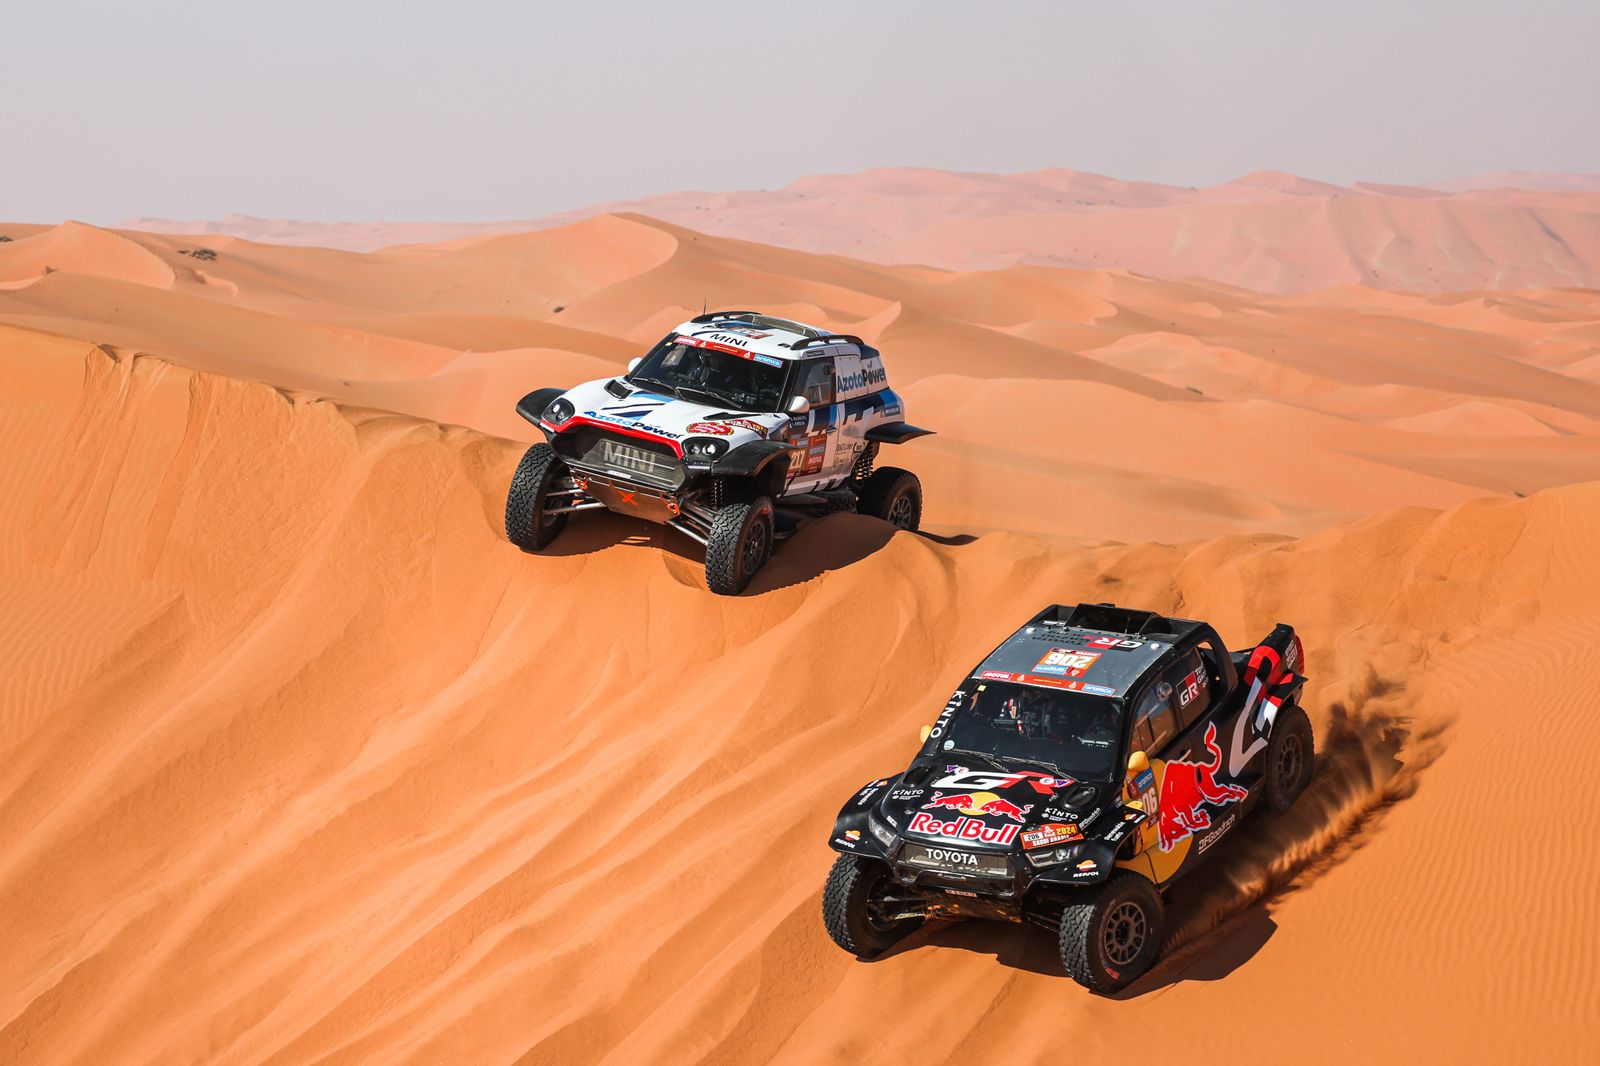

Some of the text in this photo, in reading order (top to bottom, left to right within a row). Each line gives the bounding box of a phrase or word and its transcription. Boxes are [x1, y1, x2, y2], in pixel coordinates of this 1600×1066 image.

[709, 333, 748, 347] MINI
[754, 354, 781, 367] aramco
[836, 367, 886, 393] AzotoPower
[583, 410, 686, 439] AzotoPower
[603, 441, 656, 473] MINI
[1093, 636, 1144, 650] GR
[1044, 652, 1092, 669] 206
[983, 672, 1011, 680] MOTUL
[1084, 685, 1113, 695] aramco
[1180, 681, 1199, 707] GR
[931, 770, 1075, 797] GR
[1078, 807, 1101, 829] BFGoodrich
[908, 812, 1022, 846] Red Bull
[1027, 833, 1040, 841] 206
[1055, 826, 1077, 837] 2024
[1198, 814, 1235, 851] BFGoodrich
[925, 848, 979, 866] TOYOTA
